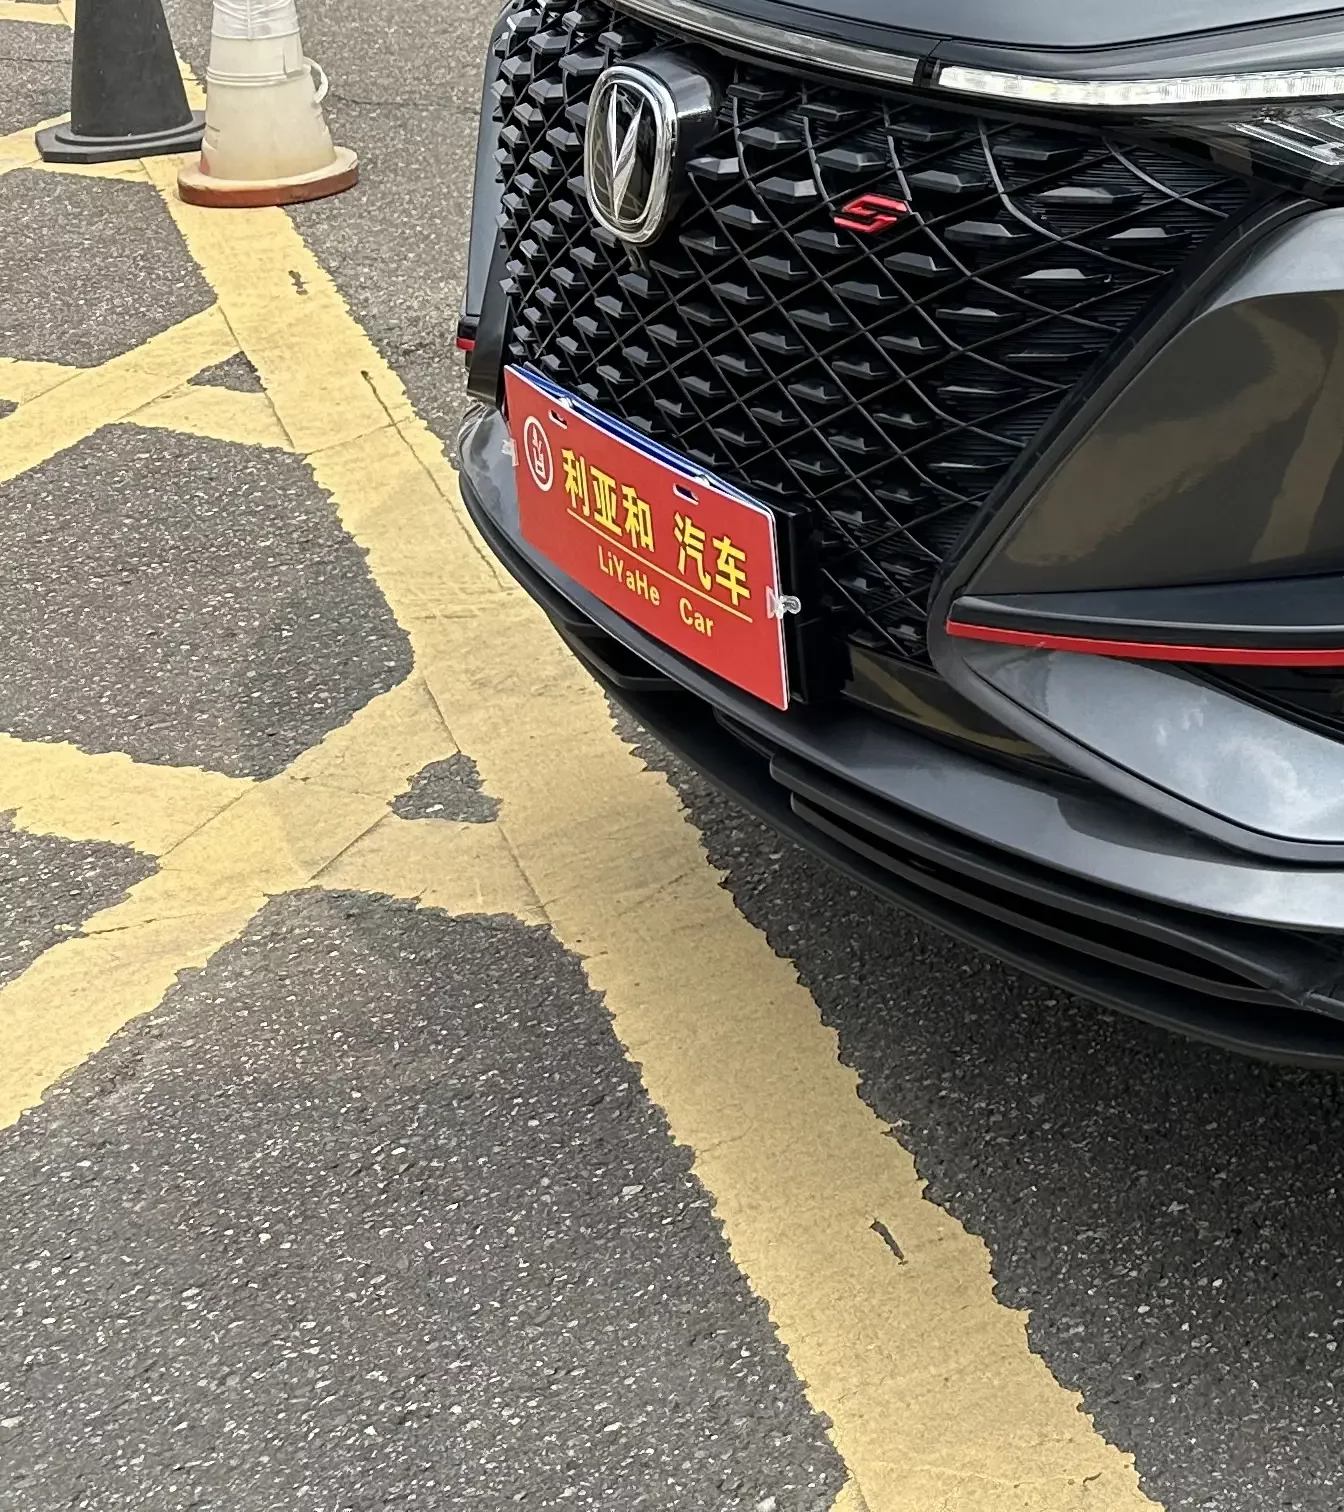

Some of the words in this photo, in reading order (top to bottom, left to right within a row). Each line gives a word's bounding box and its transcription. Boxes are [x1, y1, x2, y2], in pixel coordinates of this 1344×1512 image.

[561, 448, 655, 552] 利亚和
[674, 511, 750, 606] 汽车
[598, 545, 660, 606] LiYaHe
[679, 597, 714, 637] Car
